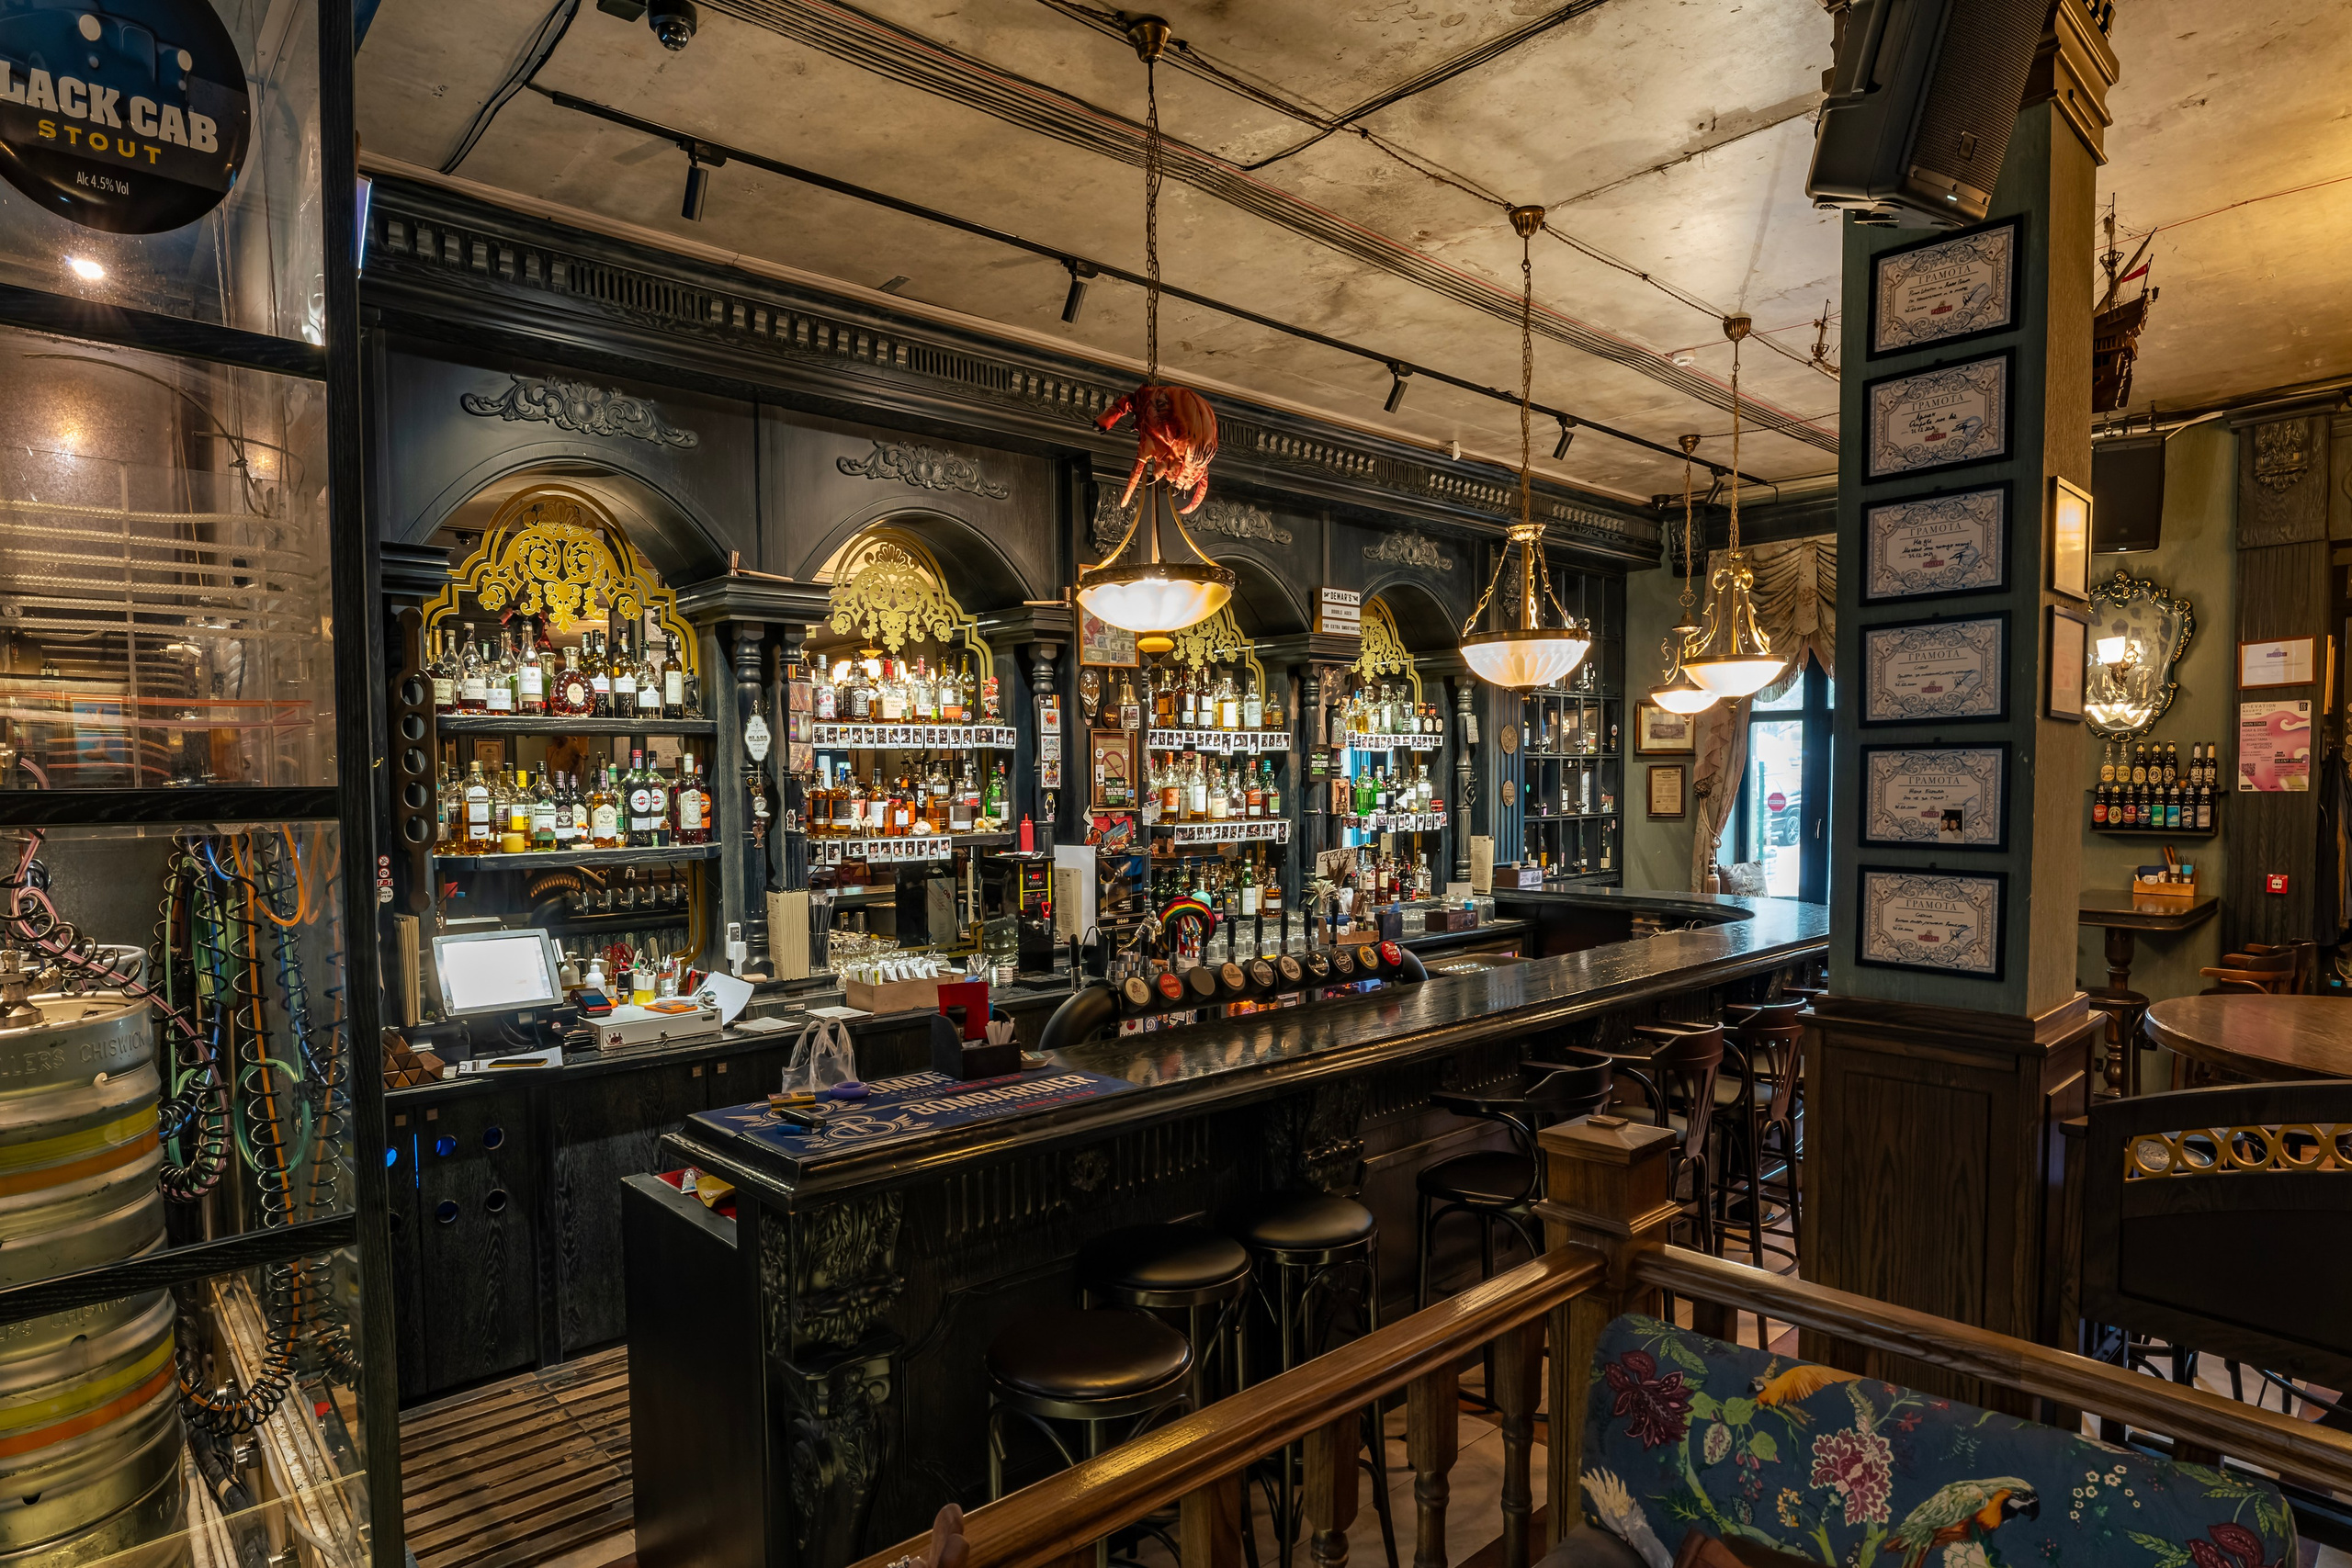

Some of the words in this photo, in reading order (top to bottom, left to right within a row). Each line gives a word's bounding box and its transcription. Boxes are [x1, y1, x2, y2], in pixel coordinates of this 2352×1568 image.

[130, 96, 220, 154] CAB
[39, 119, 162, 165] STOUT
[76, 171, 90, 187] Alc
[90, 175, 115, 193] 4.5%
[115, 179, 130, 196] Vol
[1918, 265, 1971, 285] ГРАМОТА
[1912, 393, 1963, 412] ГРАМОТА
[1910, 522, 1962, 536] ГРАМОТА
[1330, 591, 1352, 603] DEWAR'S
[1908, 649, 1960, 661] ГРАМОТА
[1908, 776, 1961, 784] ГРАМОТА
[1905, 899, 1957, 911] ГРАМОТА
[1336, 955, 1351, 965] ESB
[81, 1032, 148, 1065] CHISWICK
[868, 1071, 954, 1095] OMBA
[945, 1080, 989, 1092] AMBER
[991, 1074, 1023, 1083] BEER
[899, 1074, 1100, 1115] BOMBARDIER
[1014, 1087, 1080, 1102] BREWERY
[1015, 1097, 1062, 1110] AMBER
[1064, 1089, 1096, 1100] BEER
